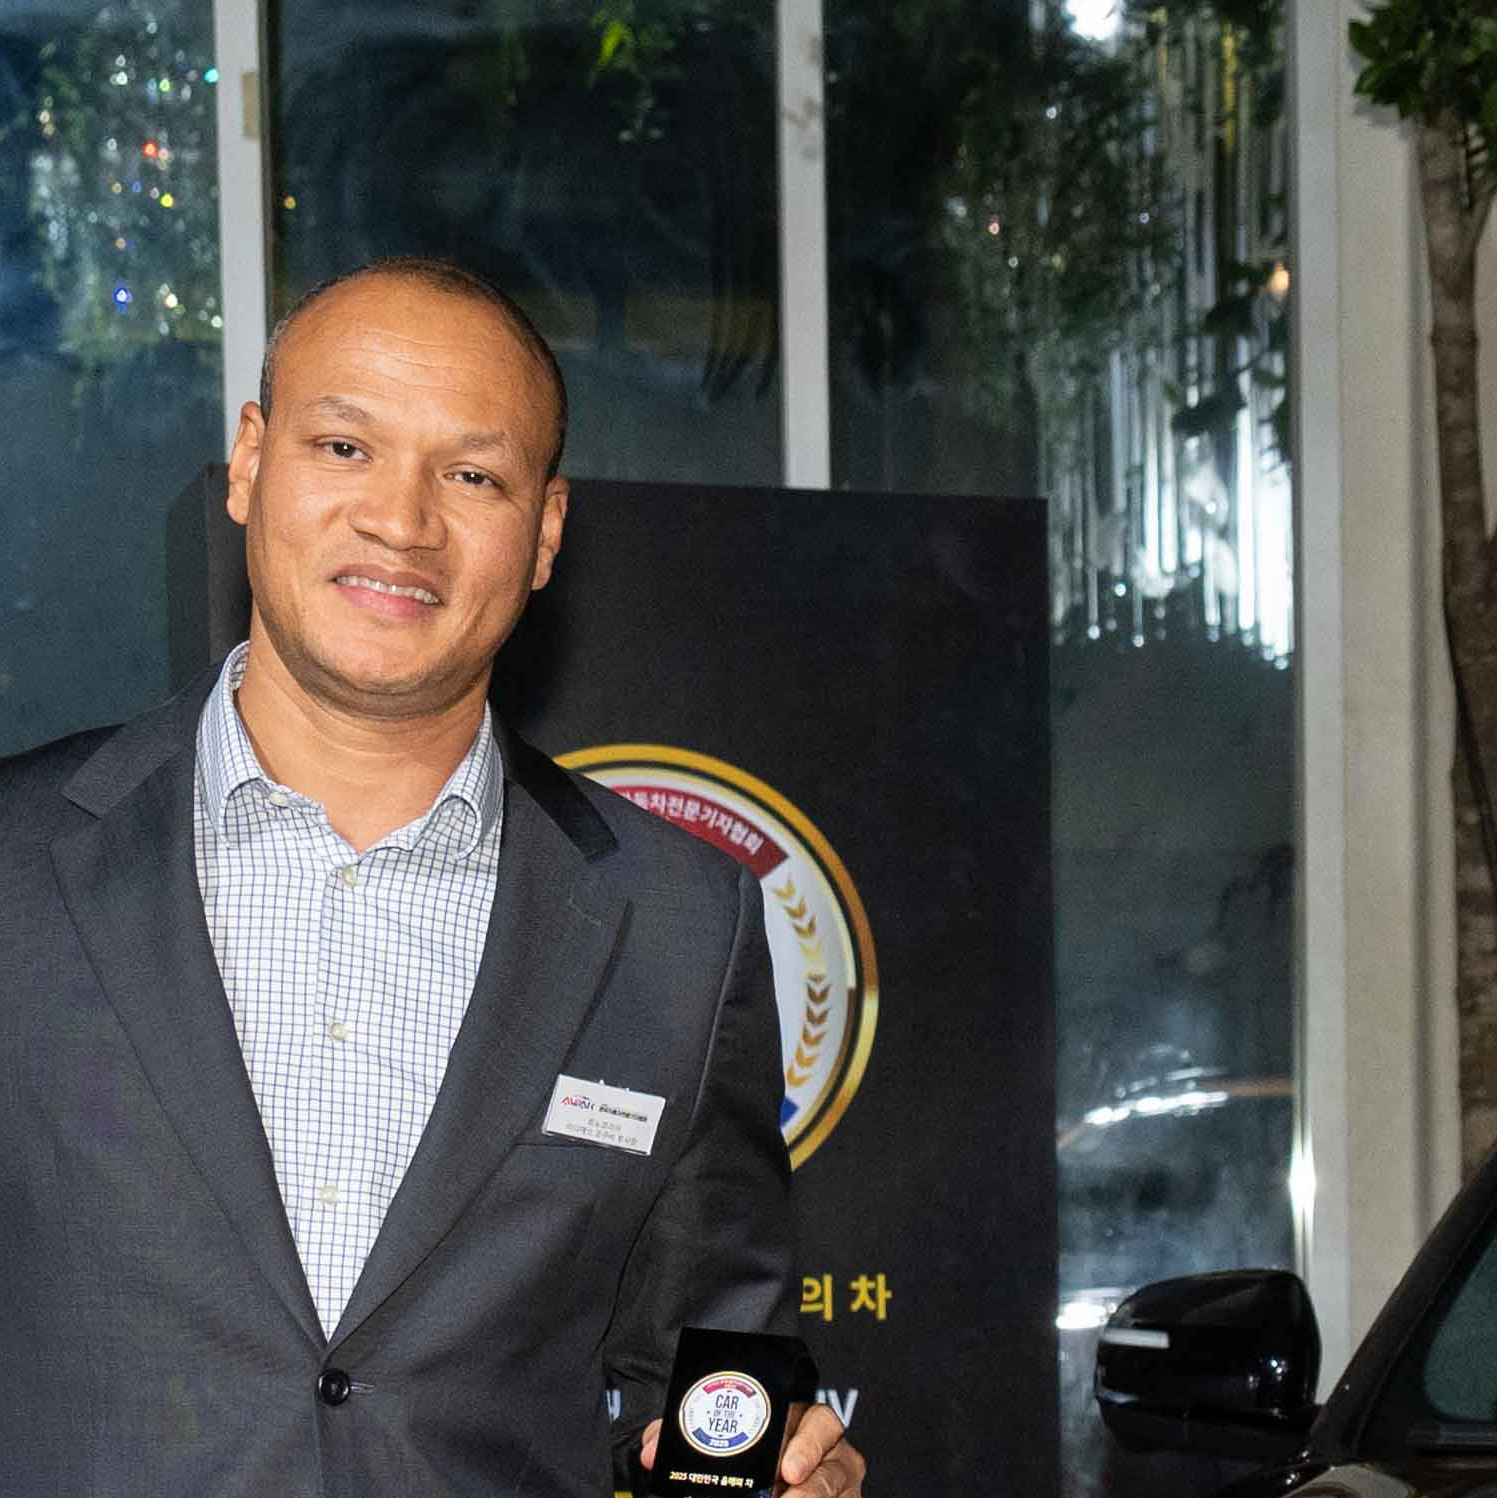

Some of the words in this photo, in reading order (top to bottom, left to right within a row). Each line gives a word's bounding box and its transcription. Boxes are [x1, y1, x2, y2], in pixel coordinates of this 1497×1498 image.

[849, 1273, 893, 1321] 차
[715, 1394, 739, 1410] CAR
[708, 1417, 738, 1433] YEAR
